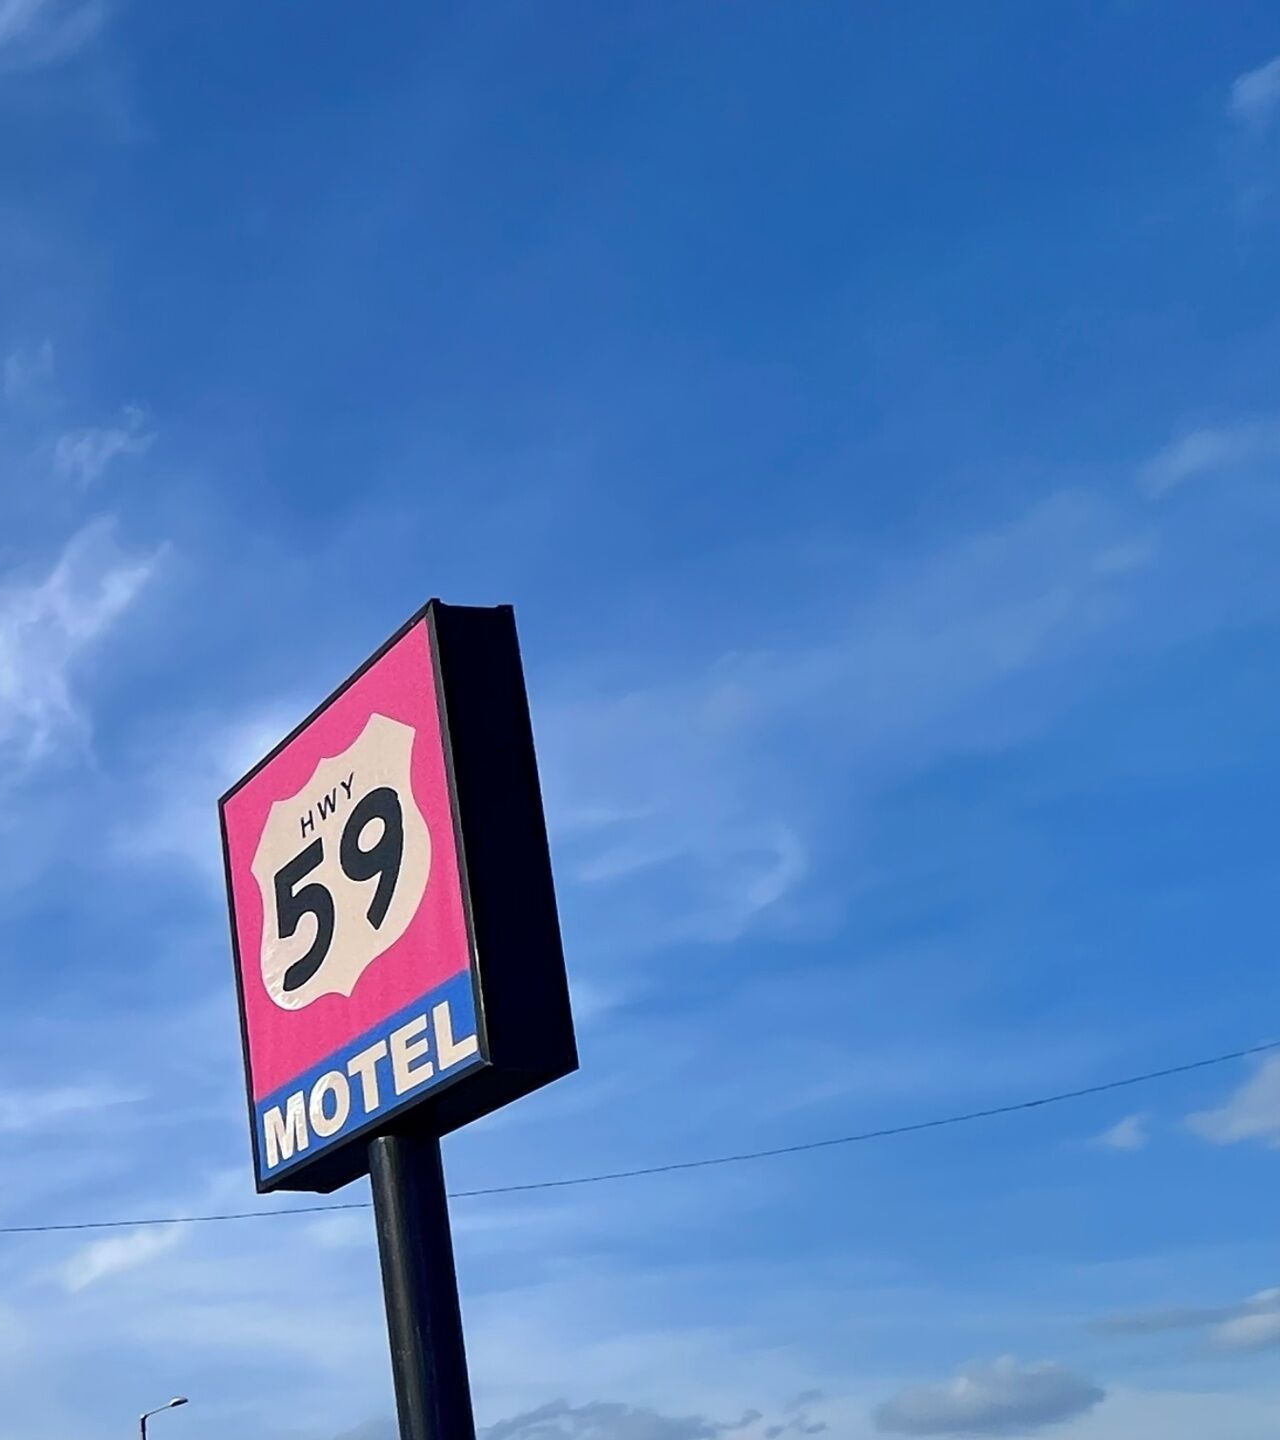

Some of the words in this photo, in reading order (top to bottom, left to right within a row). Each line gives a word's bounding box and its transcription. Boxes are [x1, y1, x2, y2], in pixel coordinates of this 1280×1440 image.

[273, 786, 404, 992] 59
[300, 772, 355, 838] HWY
[262, 1001, 479, 1169] MOTEL
